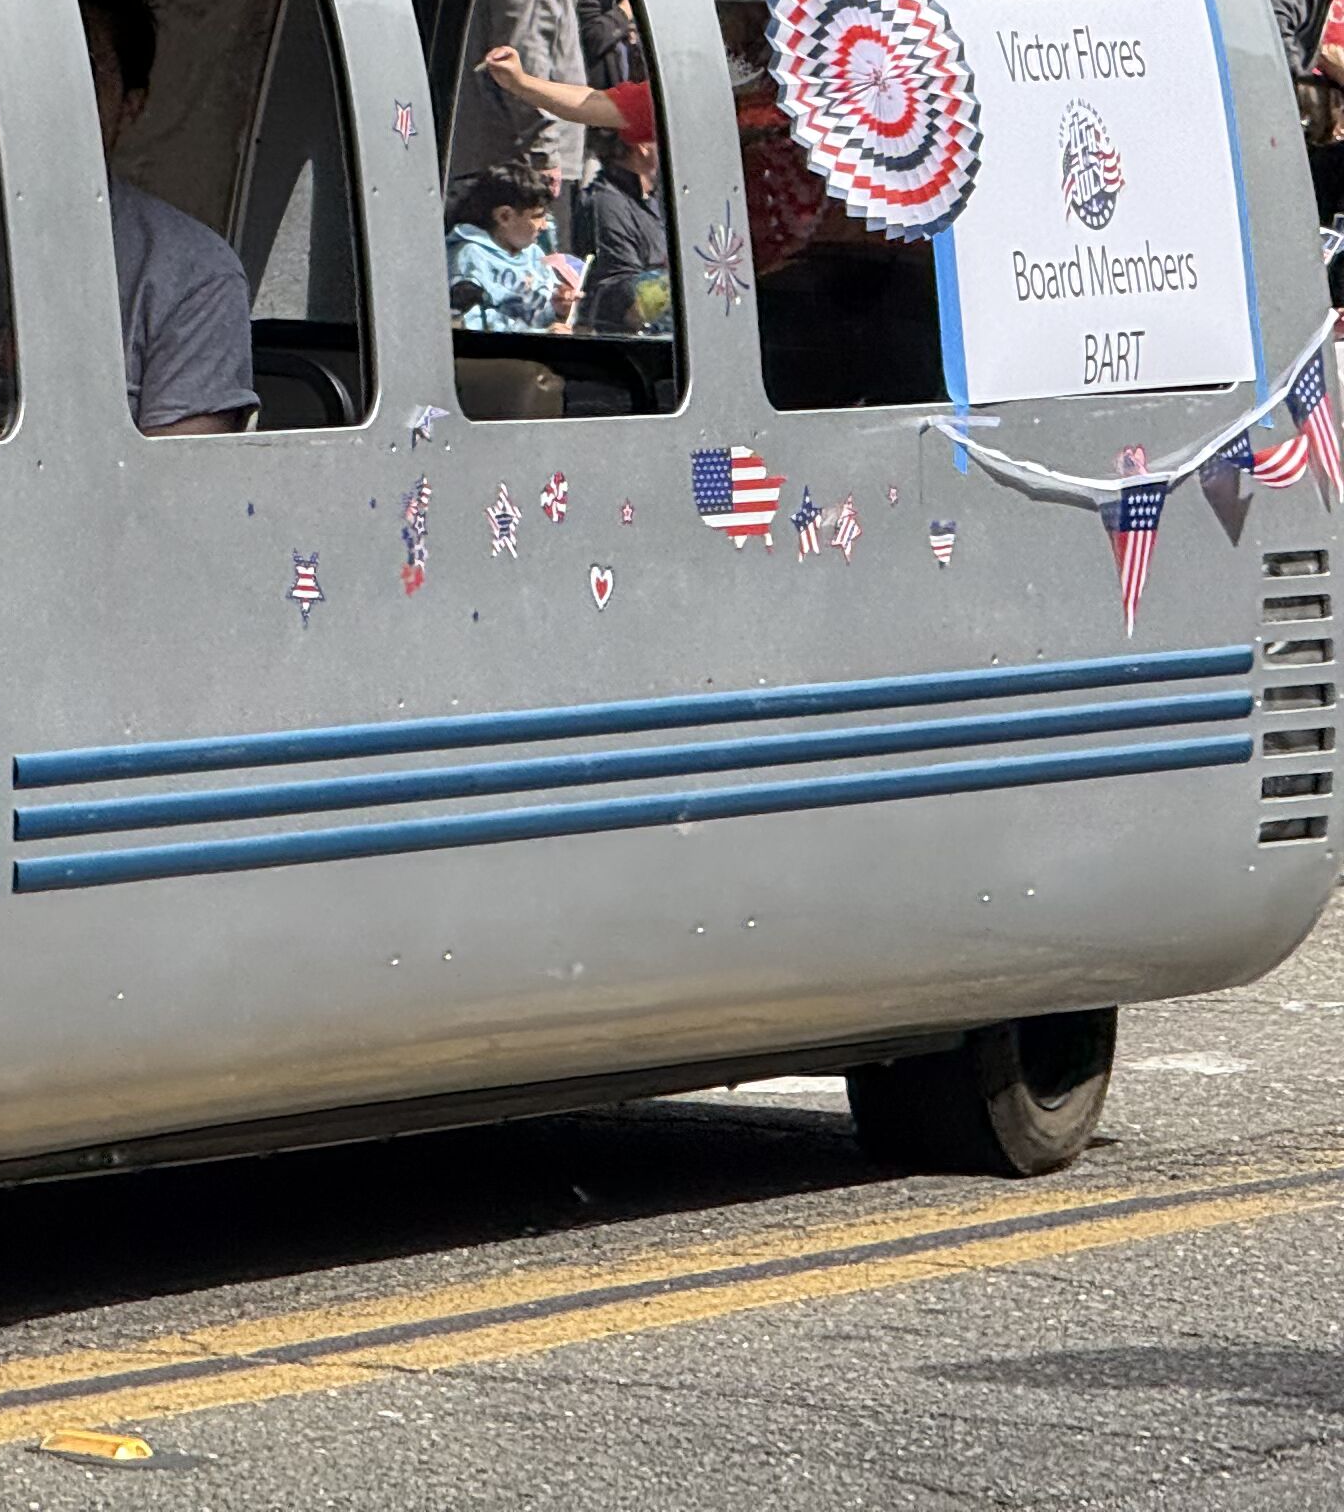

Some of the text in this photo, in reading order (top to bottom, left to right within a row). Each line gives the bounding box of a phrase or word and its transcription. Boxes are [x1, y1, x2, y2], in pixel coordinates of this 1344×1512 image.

[996, 24, 1147, 83] Victor Flores
[1012, 239, 1199, 302] Board Members
[1083, 330, 1147, 385] BART
